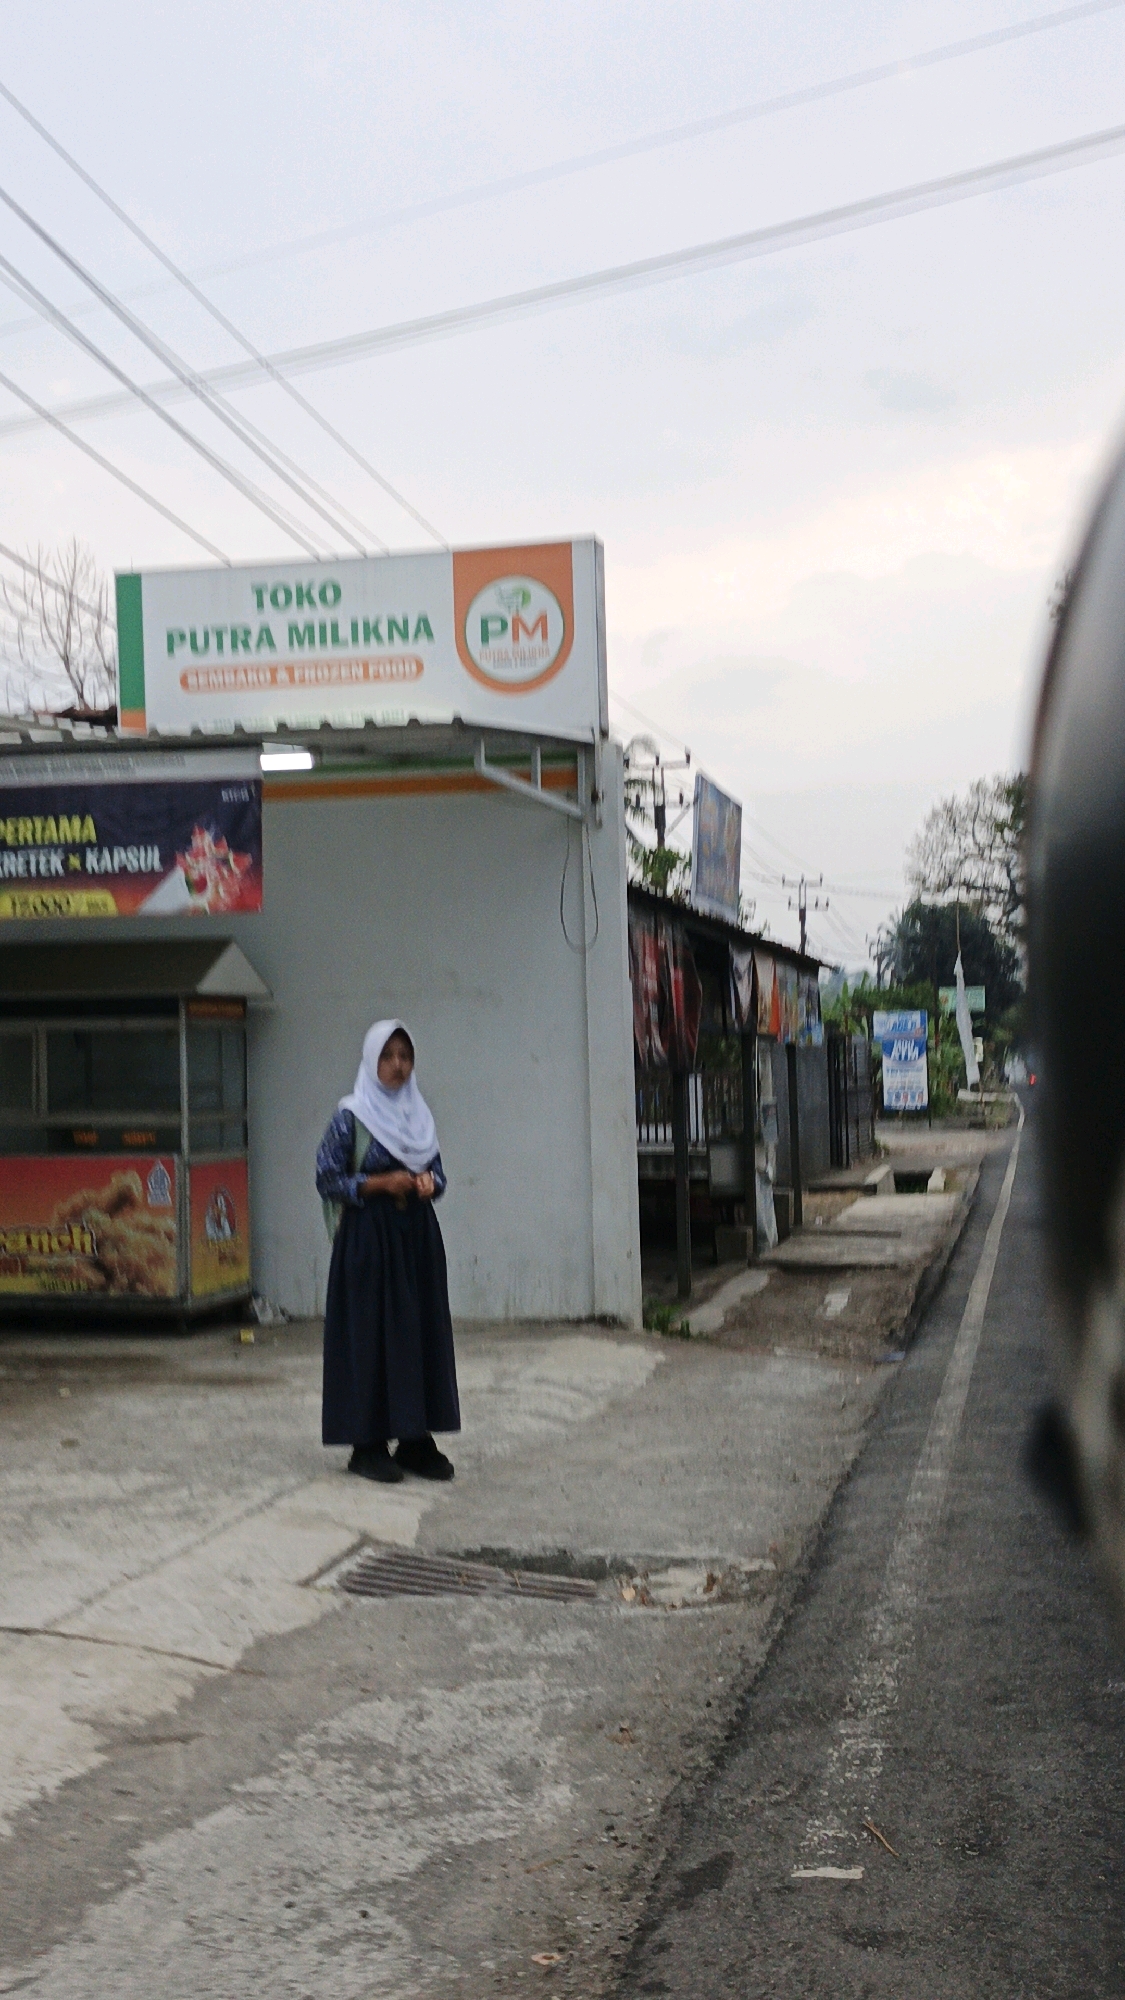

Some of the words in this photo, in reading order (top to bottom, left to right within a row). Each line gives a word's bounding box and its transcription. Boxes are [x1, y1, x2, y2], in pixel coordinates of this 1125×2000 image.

[252, 578, 342, 613] TOKO
[166, 622, 277, 657] PUTRA
[287, 612, 435, 649] MILIKNA
[480, 611, 548, 646] PM
[369, 657, 418, 681] FOOD
[85, 845, 163, 875] KAPSUL
